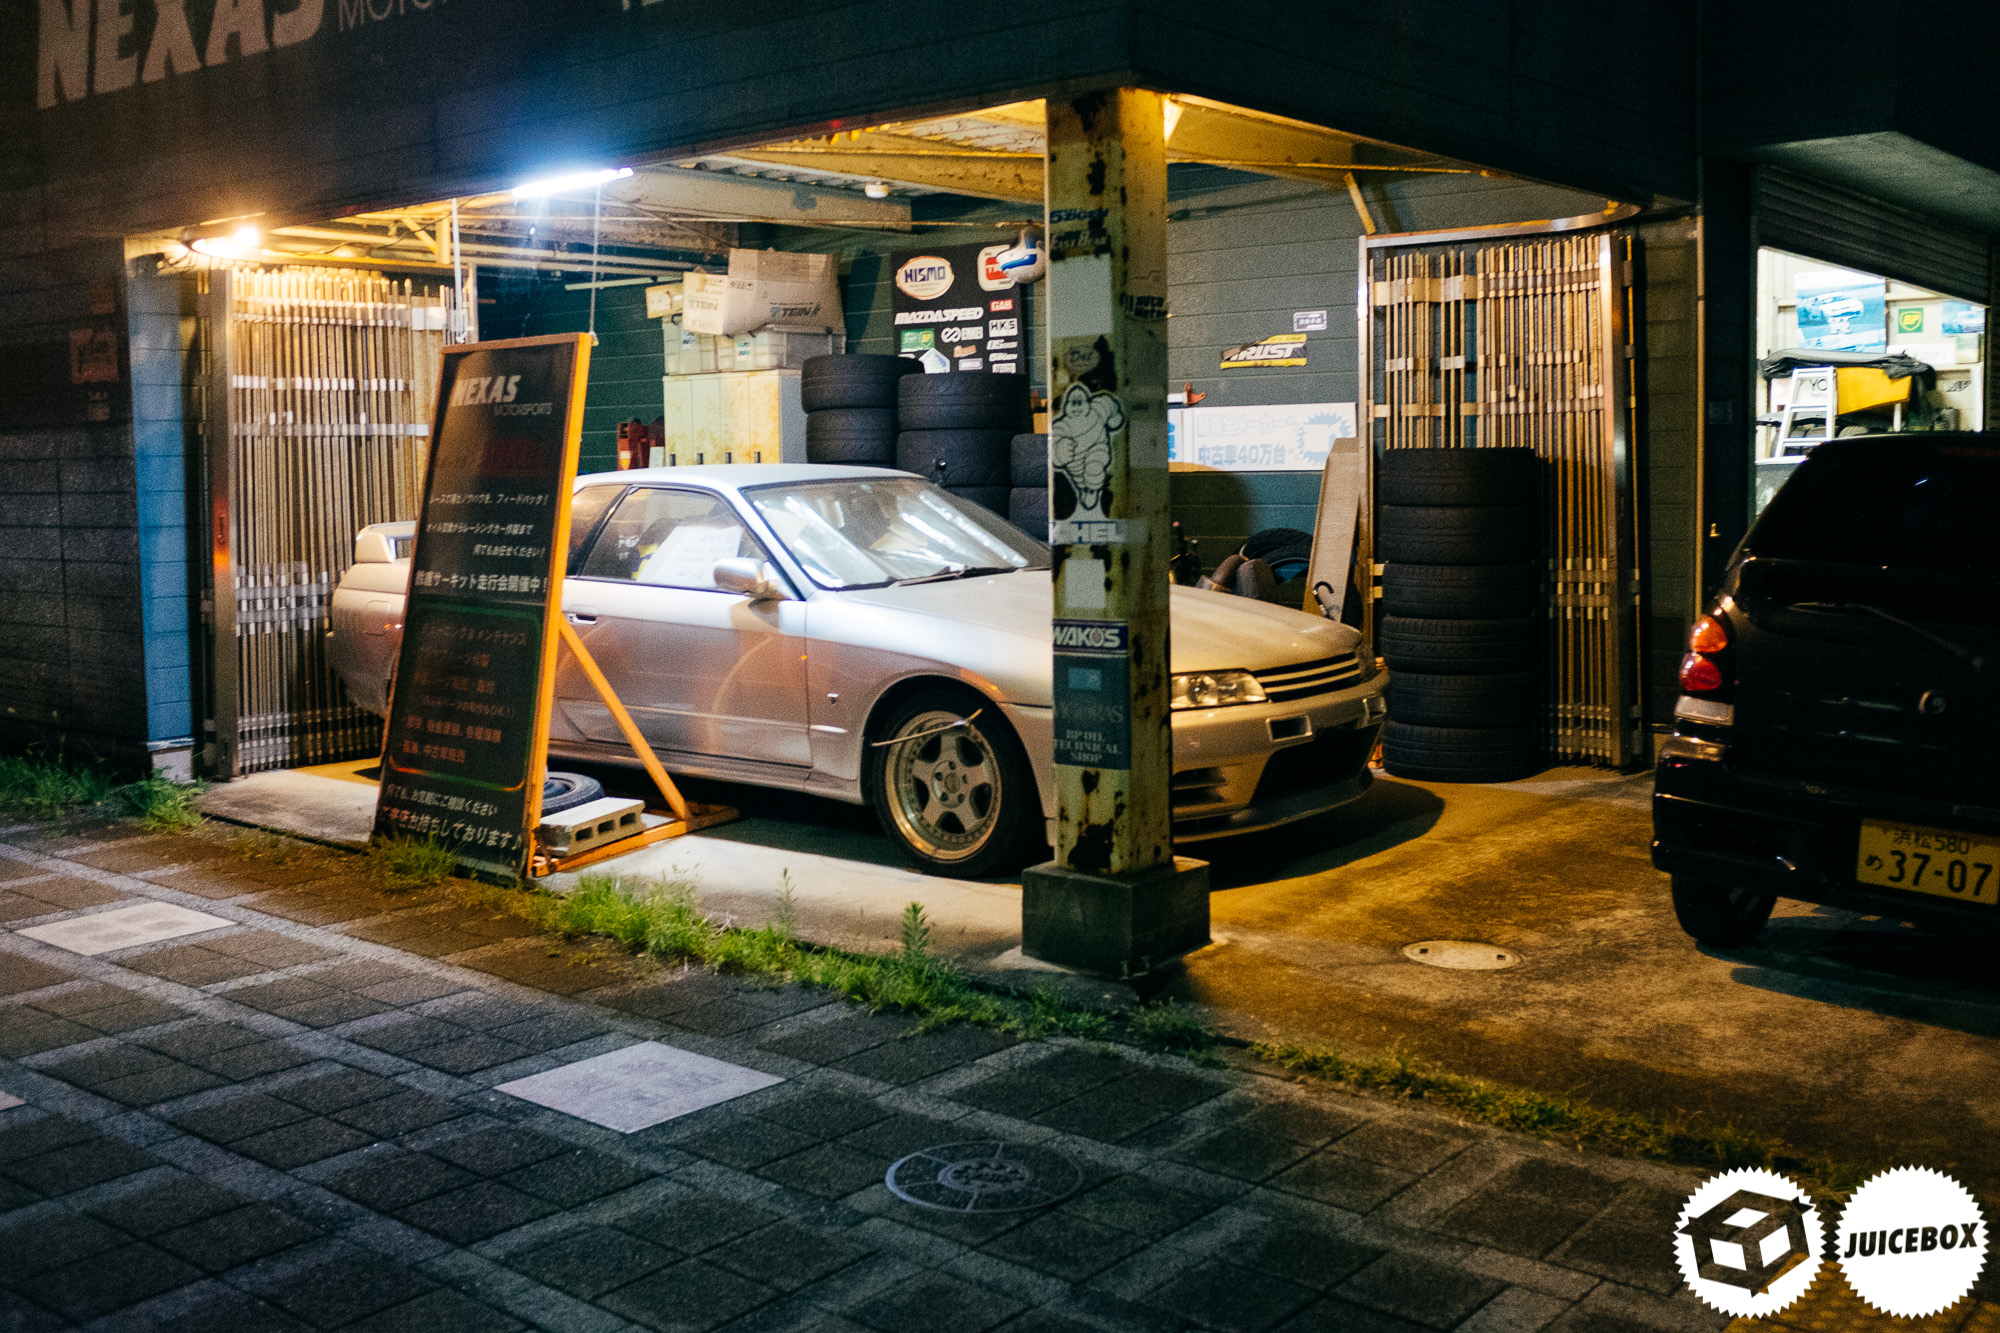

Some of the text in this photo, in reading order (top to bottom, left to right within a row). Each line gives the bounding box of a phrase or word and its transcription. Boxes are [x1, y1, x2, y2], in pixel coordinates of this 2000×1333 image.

[904, 265, 947, 283] NISMO
[781, 307, 813, 318] TEIN
[895, 307, 984, 325] MAZDASPEED
[1903, 312, 1921, 326] BP
[990, 319, 1015, 331] HKS
[451, 374, 522, 407] NEXAS
[1198, 443, 1286, 466] 中古車40万台
[1887, 849, 1994, 897] 37-07
